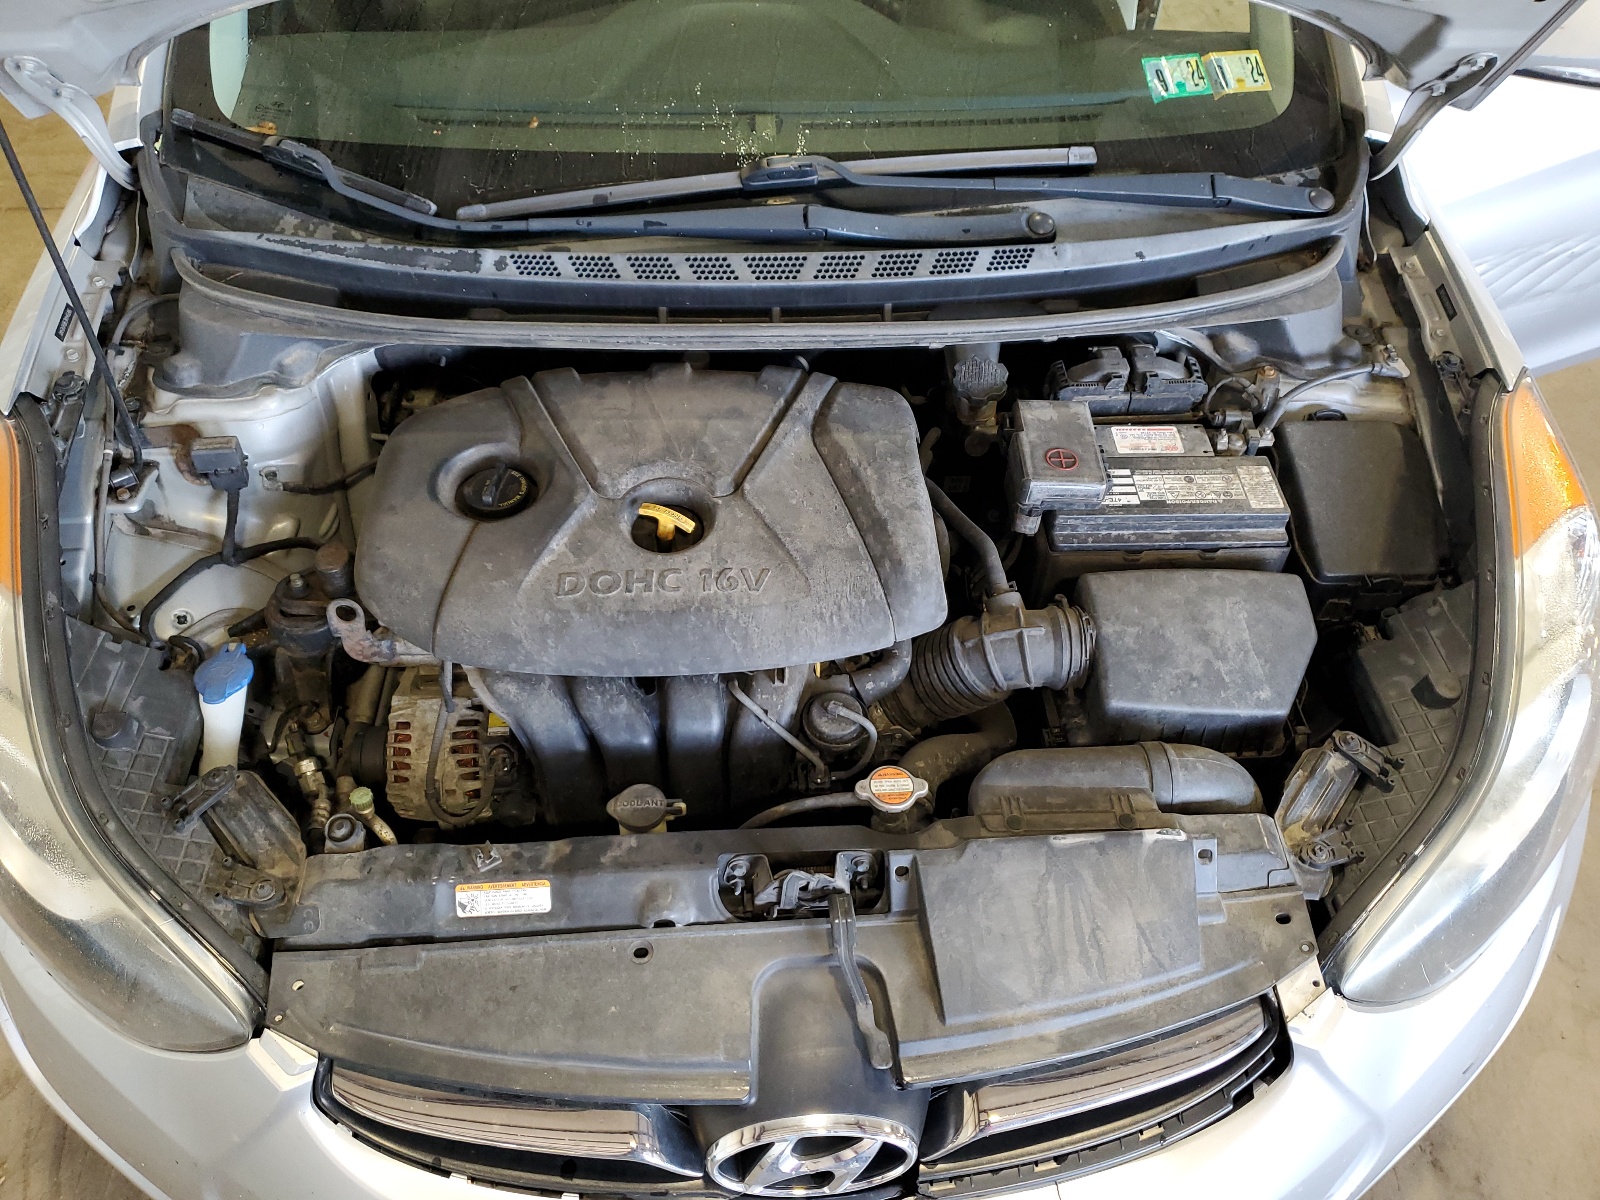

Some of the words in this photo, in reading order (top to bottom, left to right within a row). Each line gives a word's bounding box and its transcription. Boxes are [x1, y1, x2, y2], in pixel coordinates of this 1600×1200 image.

[1155, 68, 1169, 93] 9
[1186, 59, 1206, 87] 24
[1245, 56, 1266, 84] 24
[556, 568, 682, 598] DOHC
[699, 567, 772, 595] 16V
